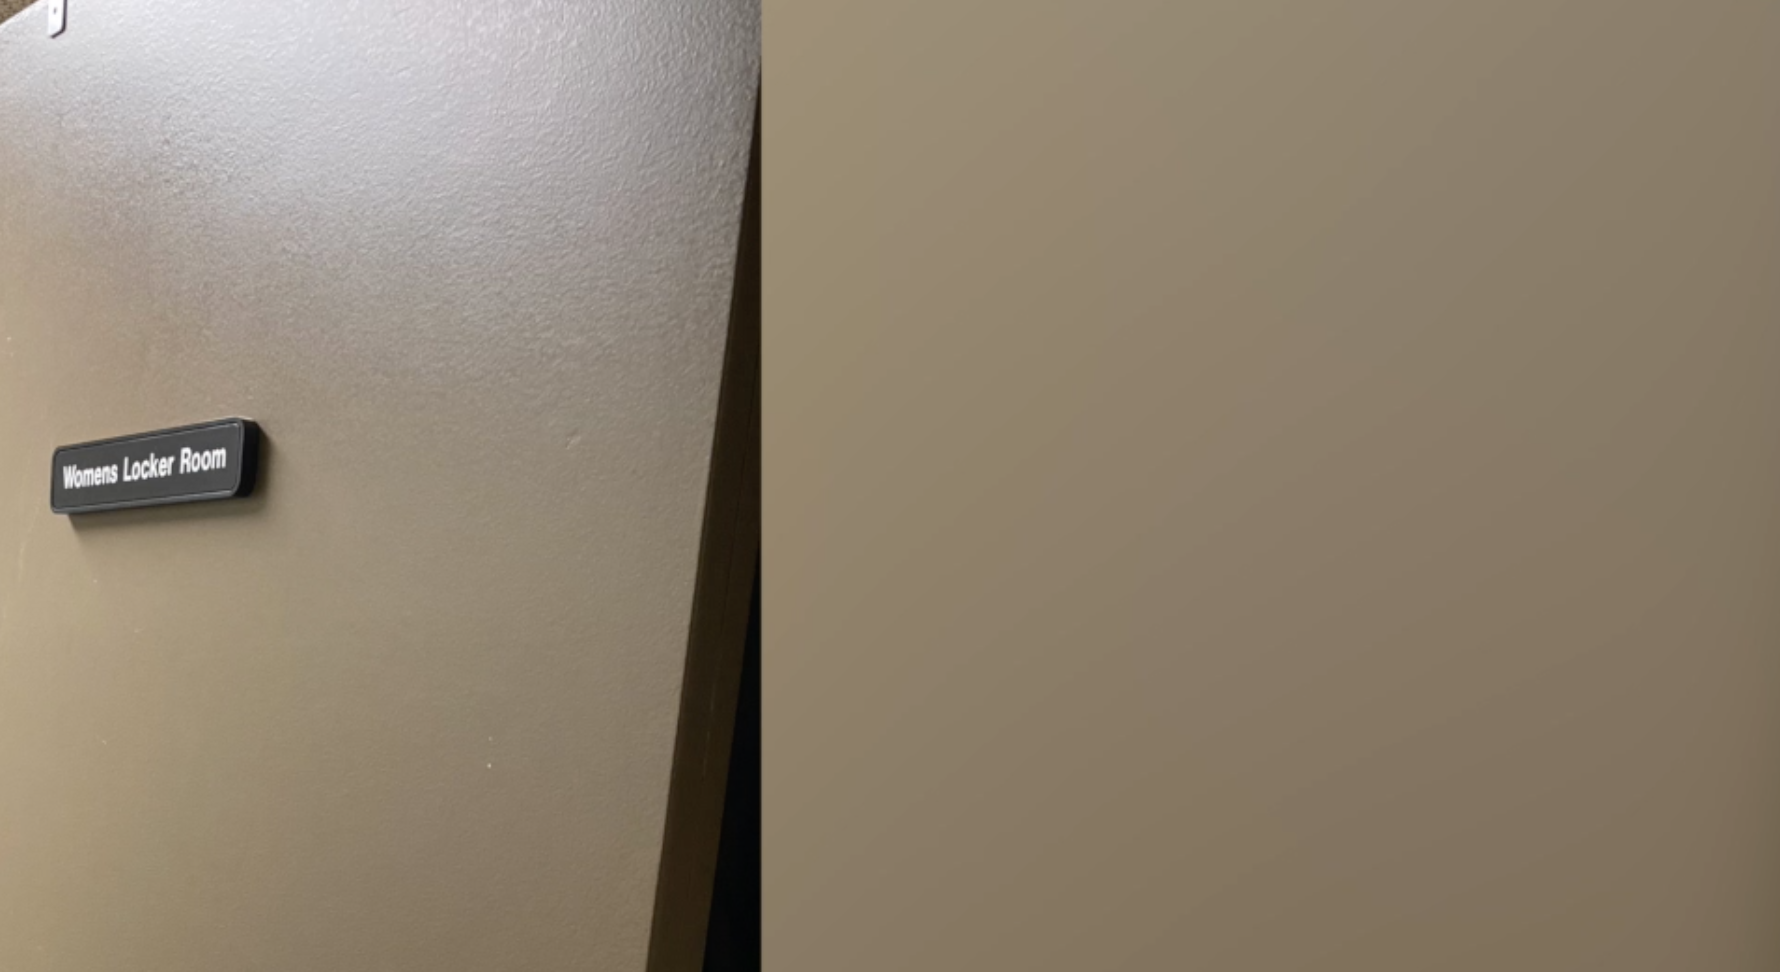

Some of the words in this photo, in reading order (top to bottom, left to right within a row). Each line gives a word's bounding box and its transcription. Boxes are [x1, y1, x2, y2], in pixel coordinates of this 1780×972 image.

[62, 463, 118, 490] Womens
[122, 452, 175, 482] Locker
[179, 446, 227, 474] Room
